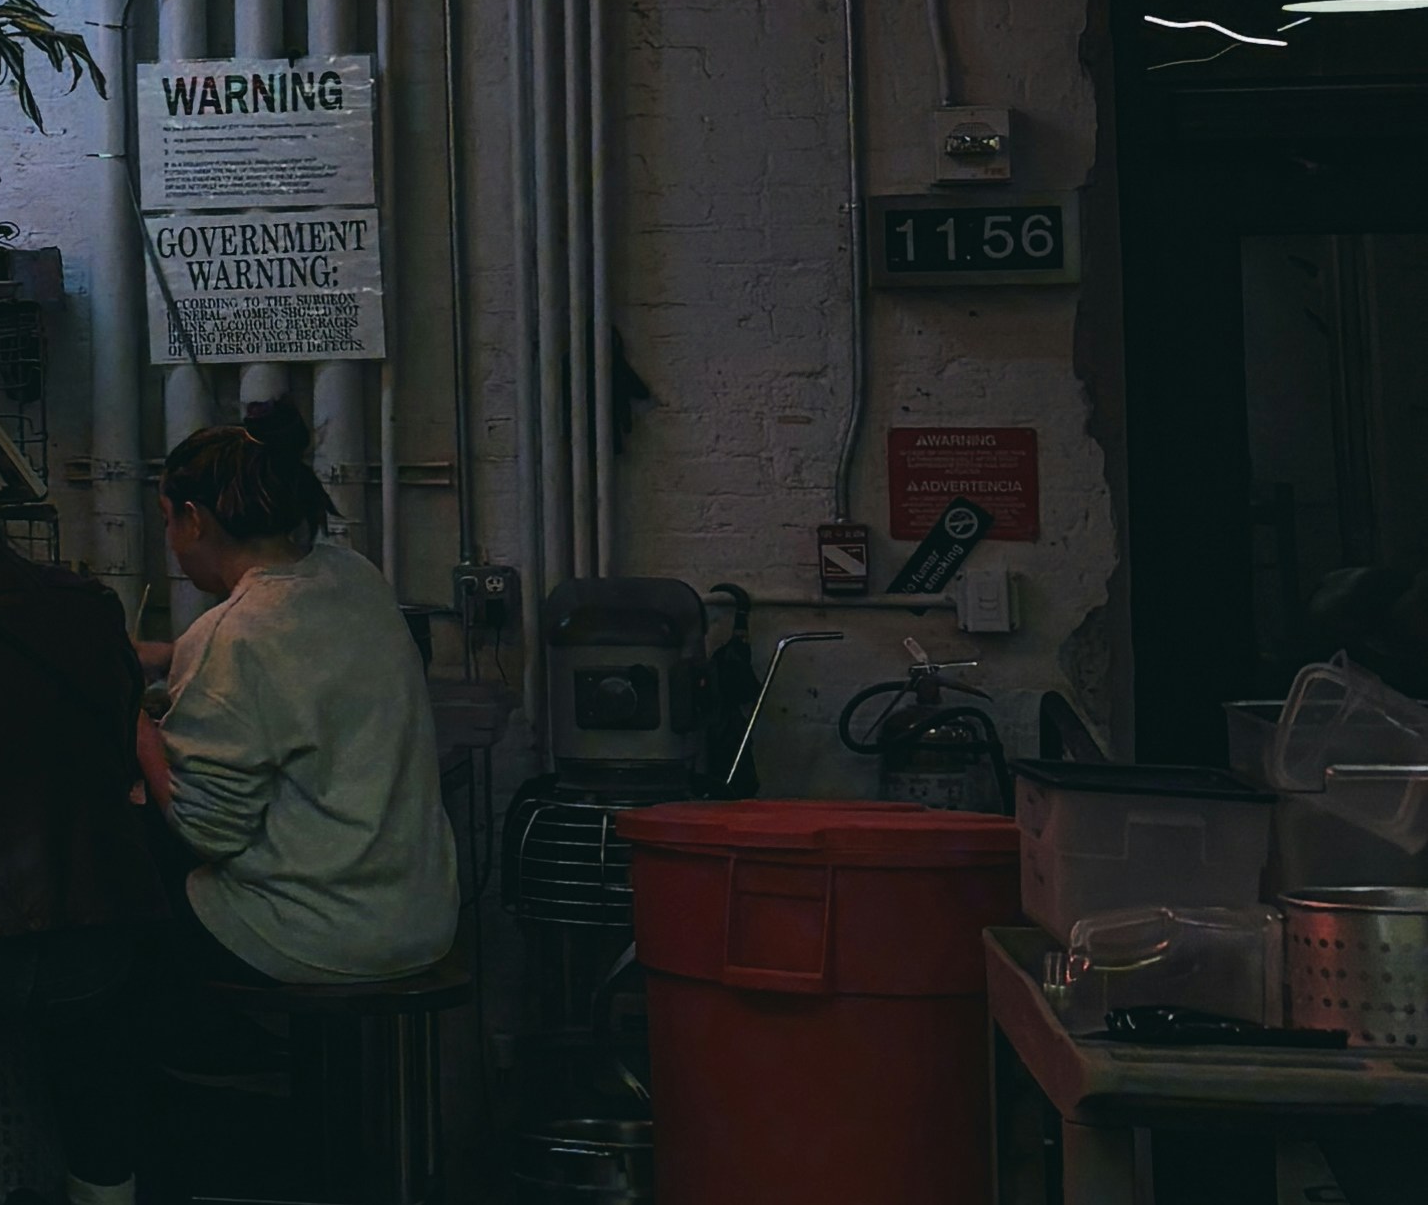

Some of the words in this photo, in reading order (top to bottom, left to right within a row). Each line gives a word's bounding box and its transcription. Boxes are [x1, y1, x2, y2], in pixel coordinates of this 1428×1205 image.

[162, 71, 344, 116] WARNING
[156, 220, 367, 259] GOVERNMENT
[187, 255, 339, 291] WARNING:
[172, 298, 238, 310] CCORDING
[243, 296, 260, 308] TO
[265, 295, 292, 307] THE
[296, 293, 357, 306] SURGEON
[232, 307, 278, 320] WOMEN
[335, 304, 359, 316] NOT
[168, 321, 206, 333] DINK
[212, 319, 283, 332] ALCOHOLIC
[286, 316, 359, 330] BEVERAGES
[168, 332, 215, 345] DUING
[219, 329, 292, 344] PREGNANCY
[295, 327, 352, 341] BECAUSE
[191, 343, 212, 356] HE
[216, 342, 243, 355] RISK
[266, 341, 304, 353] BIRTH
[926, 434, 997, 446] WARNING
[919, 480, 1023, 492] ADVERTENCIA
[911, 549, 940, 584] fumar
[924, 544, 965, 591] smoking
